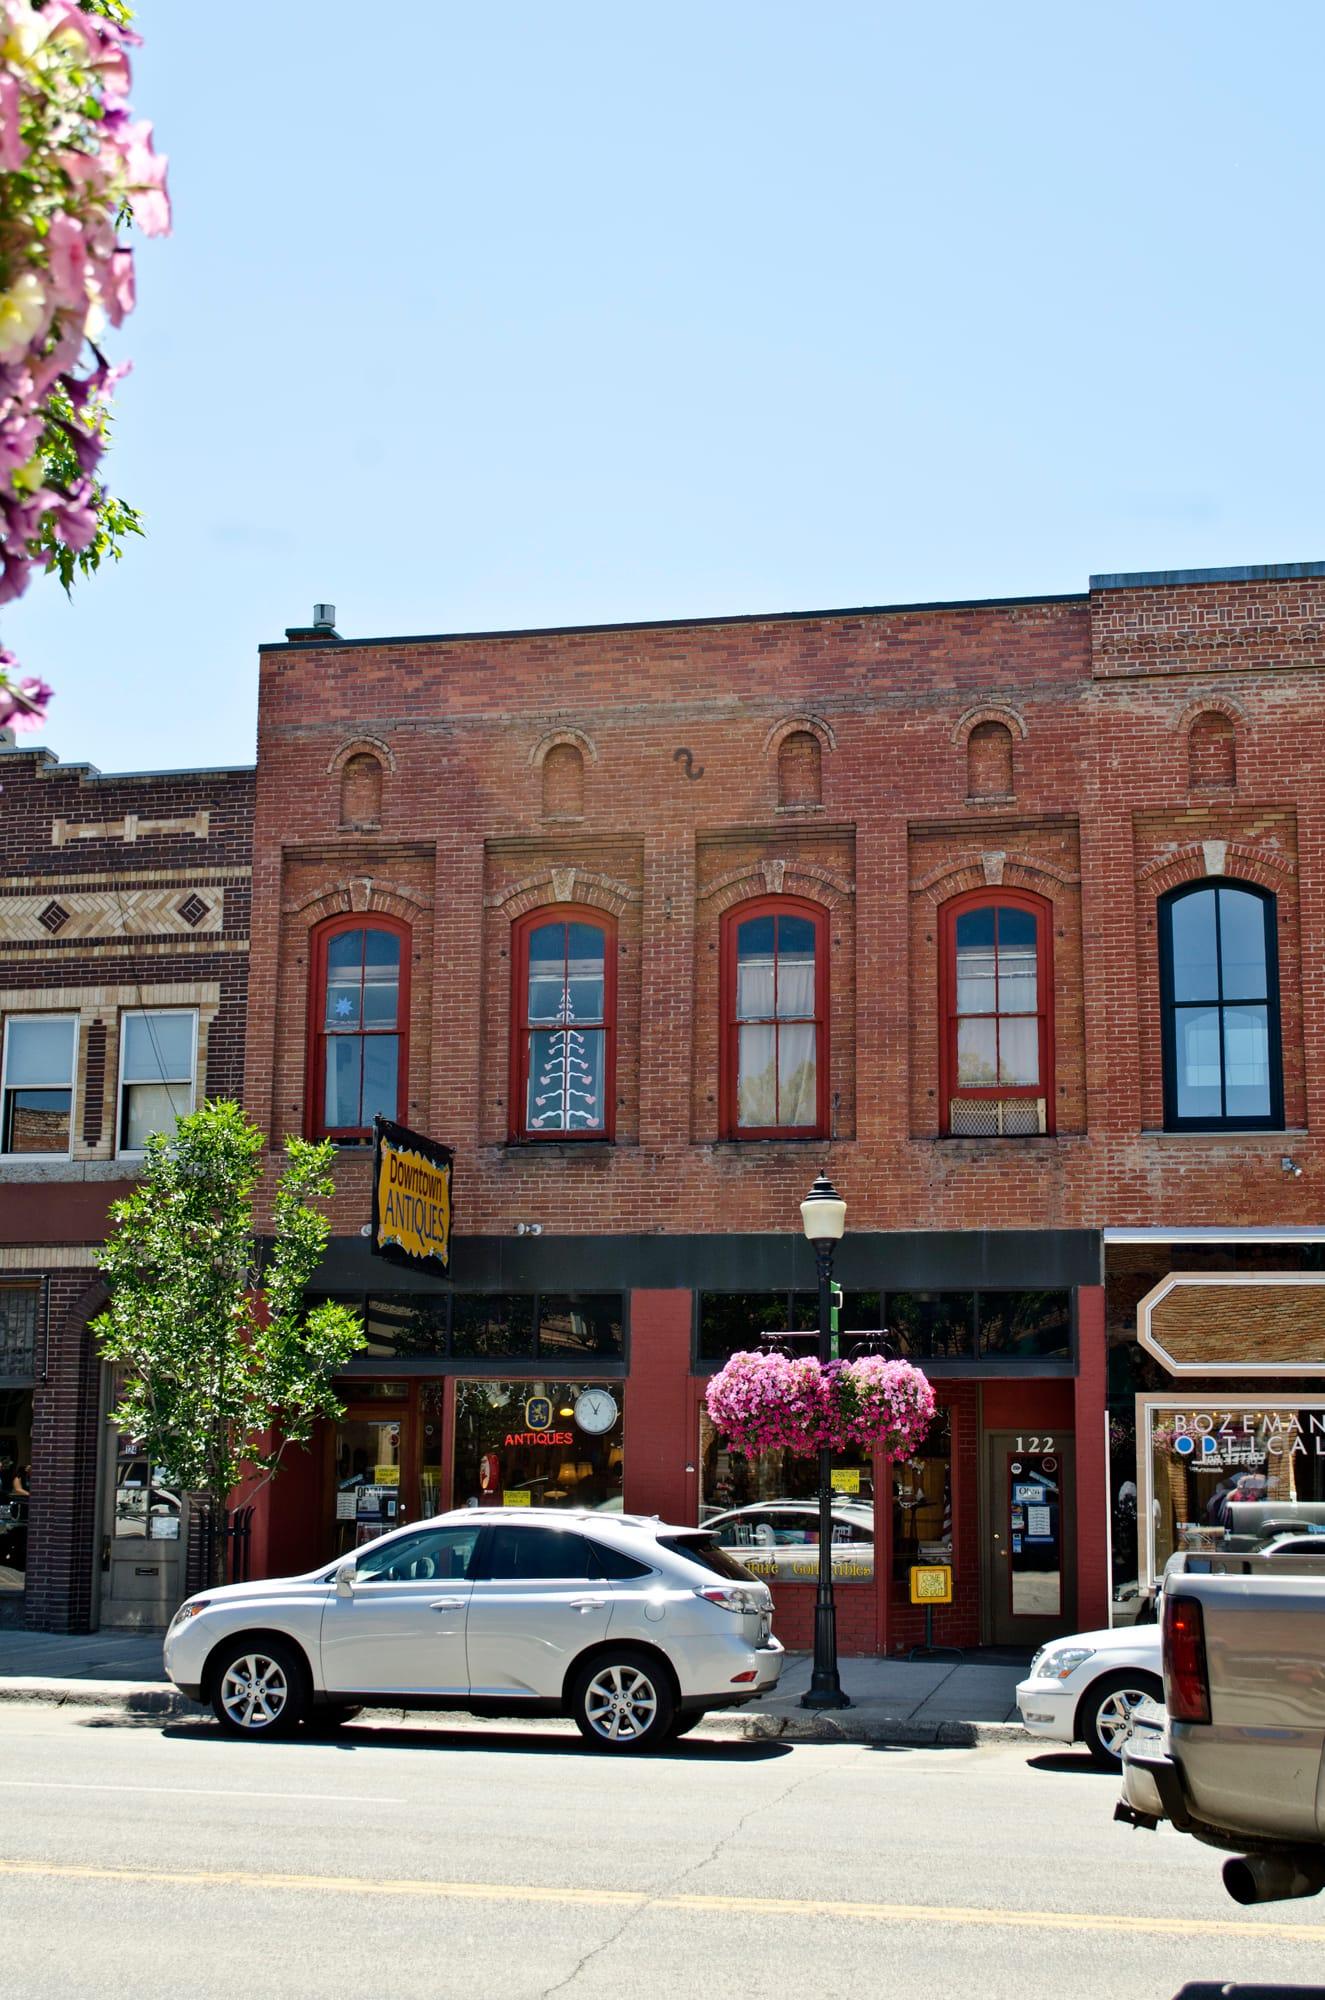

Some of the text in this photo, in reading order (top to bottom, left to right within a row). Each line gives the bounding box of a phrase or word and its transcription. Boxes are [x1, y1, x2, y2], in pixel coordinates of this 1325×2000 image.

[389, 1153, 442, 1203] Downtown
[384, 1188, 445, 1247] ANTIQUES
[1174, 1414, 1325, 1433] BOZEMAN
[504, 1432, 574, 1446] ANTIQUES
[1015, 1436, 1055, 1453] 122
[1174, 1435, 1325, 1463] OPTICAL
[792, 1559, 872, 1577] Colltibles
